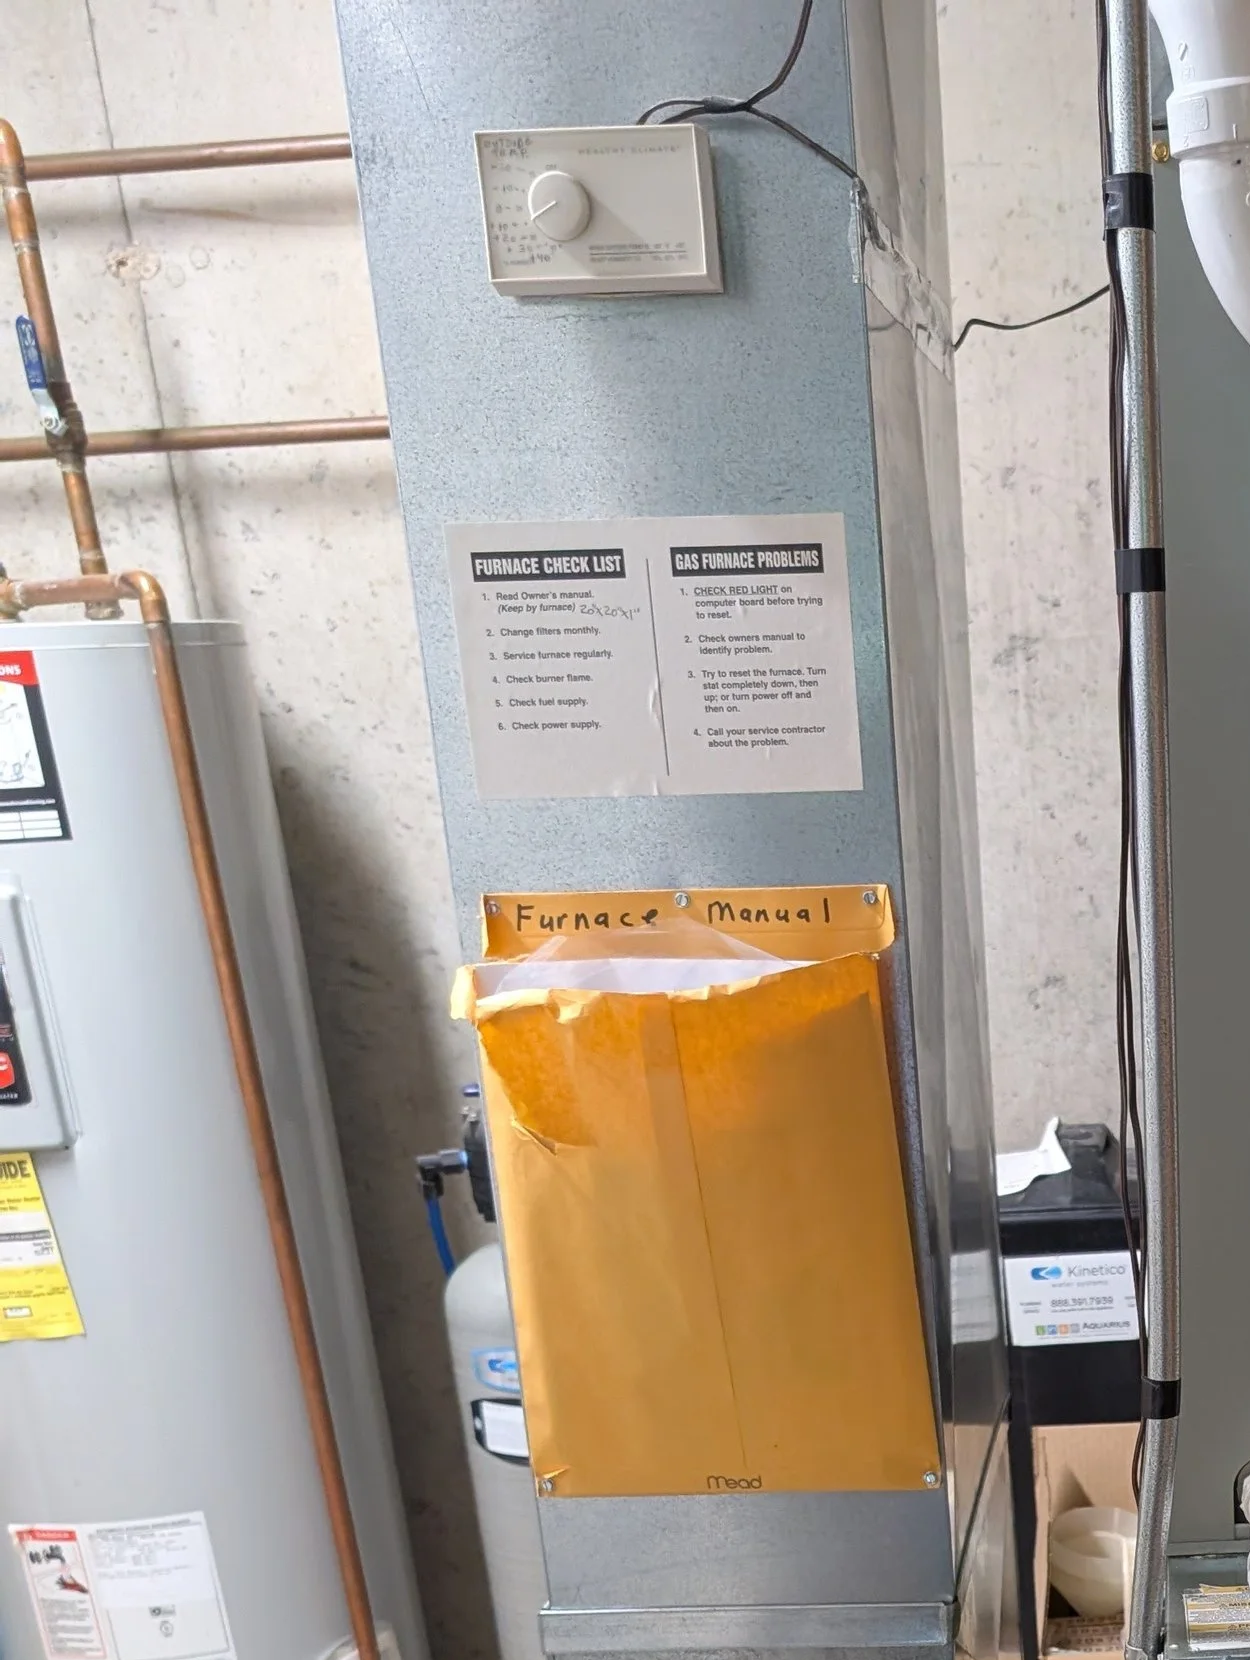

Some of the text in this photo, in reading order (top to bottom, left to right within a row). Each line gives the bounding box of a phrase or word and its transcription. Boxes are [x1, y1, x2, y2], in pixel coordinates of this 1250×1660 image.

[475, 554, 622, 577] FURNACE CHECK LIST
[675, 549, 820, 571] GAS FURNACE PROBLEMS
[482, 589, 595, 602] 1. Read Owner's manual.
[680, 585, 793, 597] 1. CHECK RED LIGHT on
[498, 602, 576, 615] (Keep by furnace)
[695, 596, 824, 610] computer board before trying
[696, 610, 732, 620] to reset.
[486, 625, 601, 638] 2. Change filters monthly.
[684, 632, 806, 644] 2. Check owners manual to
[489, 649, 614, 661] 3. Service furnace regularly.
[699, 645, 773, 657] identify problem.
[492, 673, 594, 684] 4. Check burner flame.
[688, 666, 827, 680] 3. Try to reset the furnace. Turn
[702, 678, 819, 691] stat completely down, then
[495, 696, 589, 708] 5. Check fuel supply.
[720, 693, 730, 702] or
[732, 692, 750, 701] turn
[752, 692, 779, 702] power
[781, 690, 793, 700] off
[795, 690, 812, 699] and
[705, 704, 741, 713] then on.
[498, 719, 601, 732] 6. Check power supply.
[693, 725, 826, 738] 4. Call your service contractor
[708, 737, 789, 749] about the problem.
[516, 897, 831, 934] Furnace Manual
[1067, 1264, 1126, 1278] Kinetico
